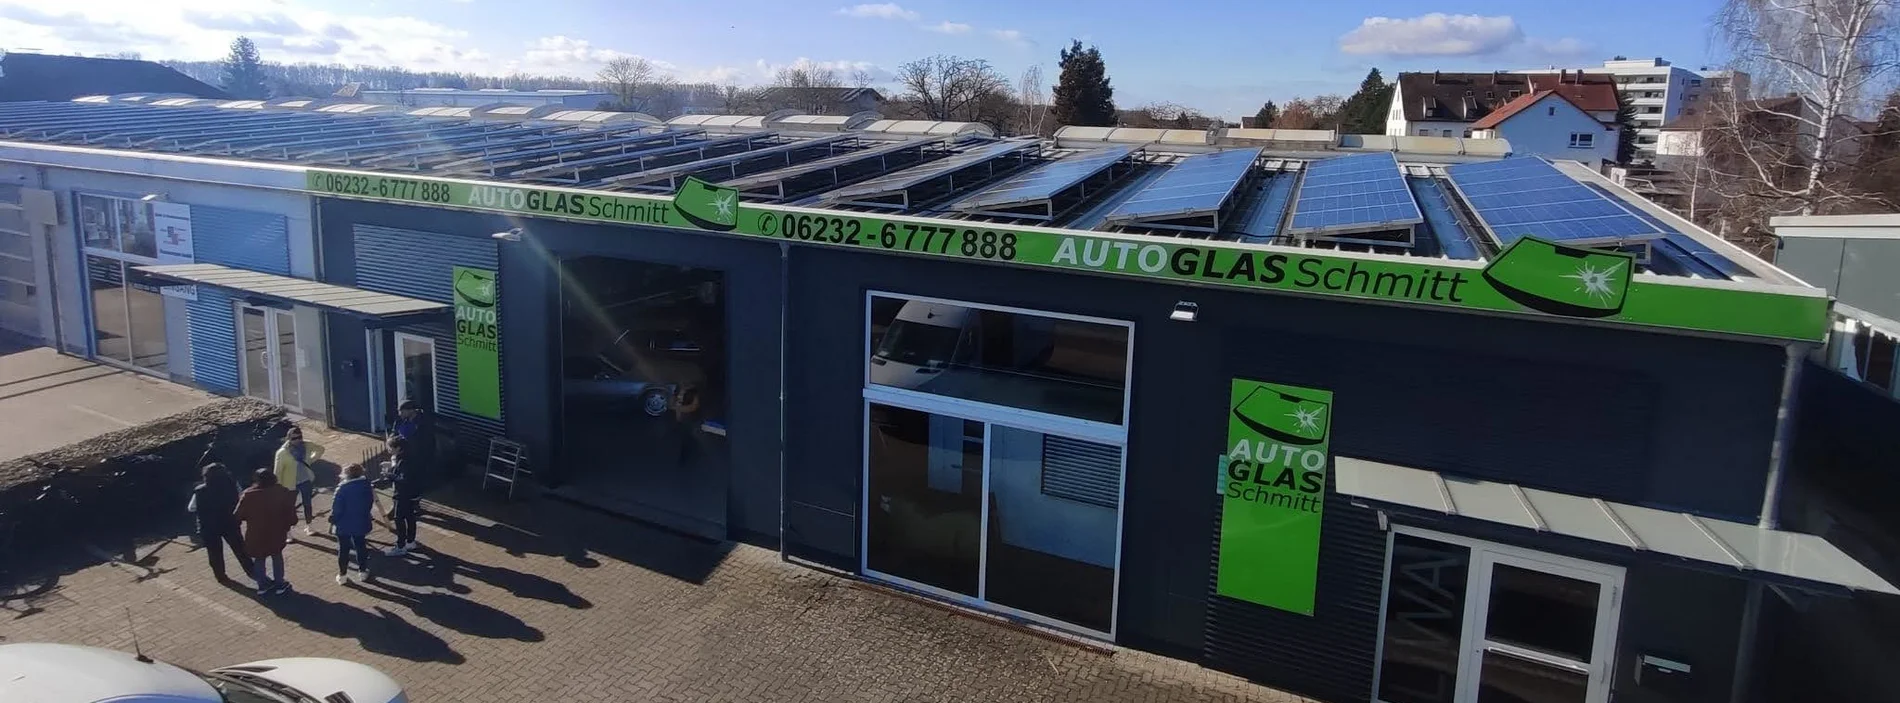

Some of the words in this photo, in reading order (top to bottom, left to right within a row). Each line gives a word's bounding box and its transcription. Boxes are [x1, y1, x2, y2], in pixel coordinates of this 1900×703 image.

[588, 196, 669, 224] Schmitt
[1294, 257, 1469, 302] Schmitt
[456, 305, 496, 324] AUTO
[457, 319, 497, 340] GLAS
[457, 333, 497, 352] Schmitt
[1230, 438, 1325, 471] AUTO
[1228, 459, 1323, 494] GLAS
[1227, 481, 1321, 514] Schmitt
